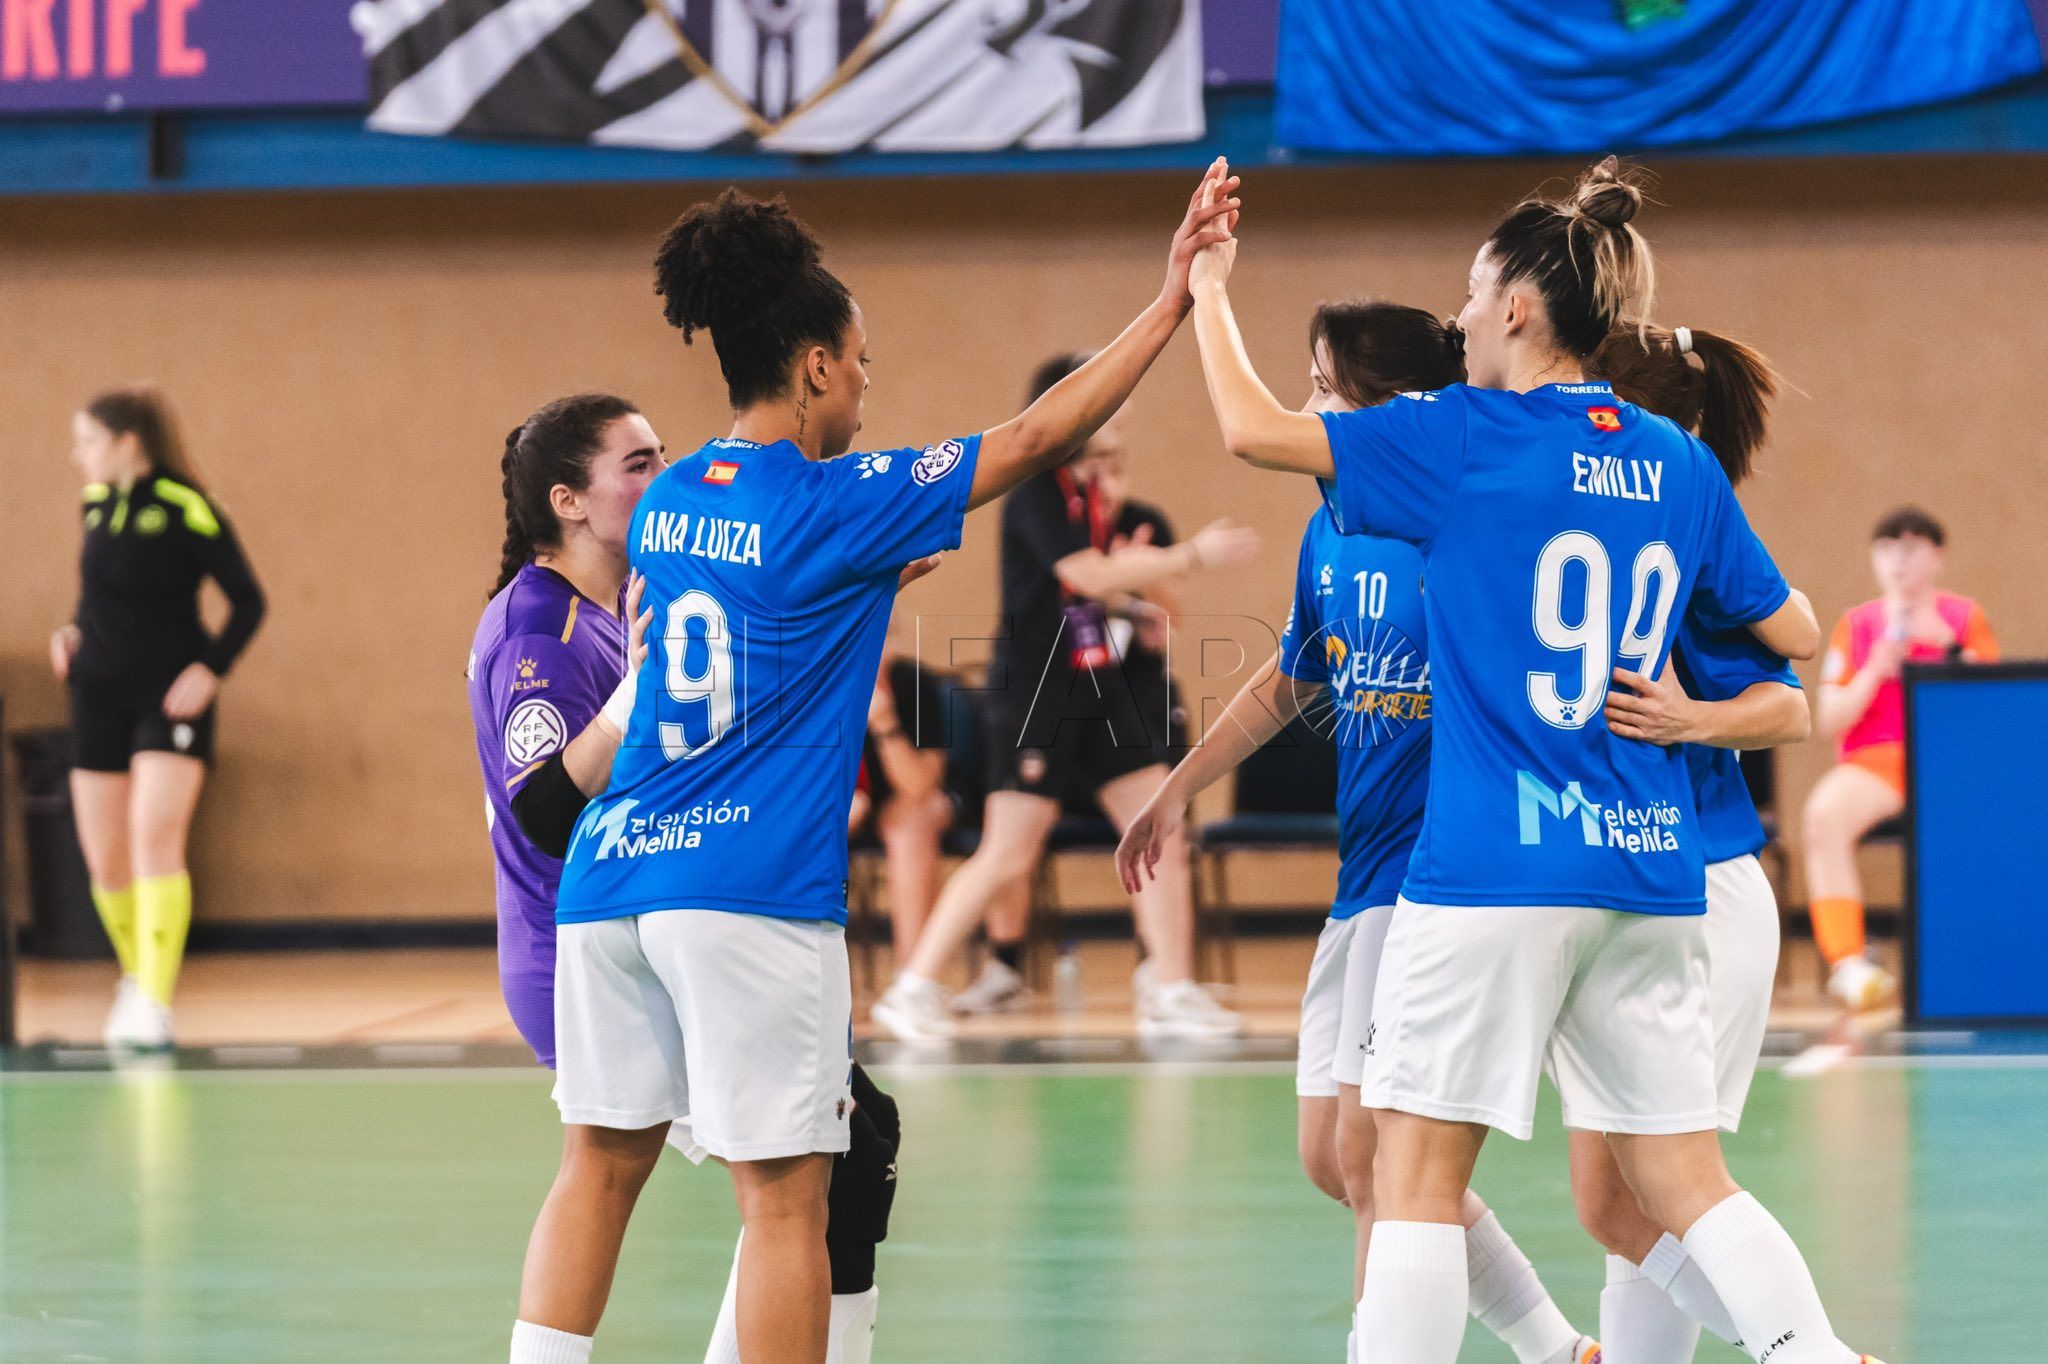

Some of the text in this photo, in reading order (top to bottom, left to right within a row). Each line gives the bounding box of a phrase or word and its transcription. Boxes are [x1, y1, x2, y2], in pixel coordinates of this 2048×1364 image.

[1555, 384, 1613, 394] TORREBLA
[1572, 451, 1662, 502] EMILLY
[640, 510, 762, 567] ANA LUIZA
[1353, 571, 1388, 620] 10
[1527, 529, 1681, 730] 99
[658, 588, 737, 763] 9
